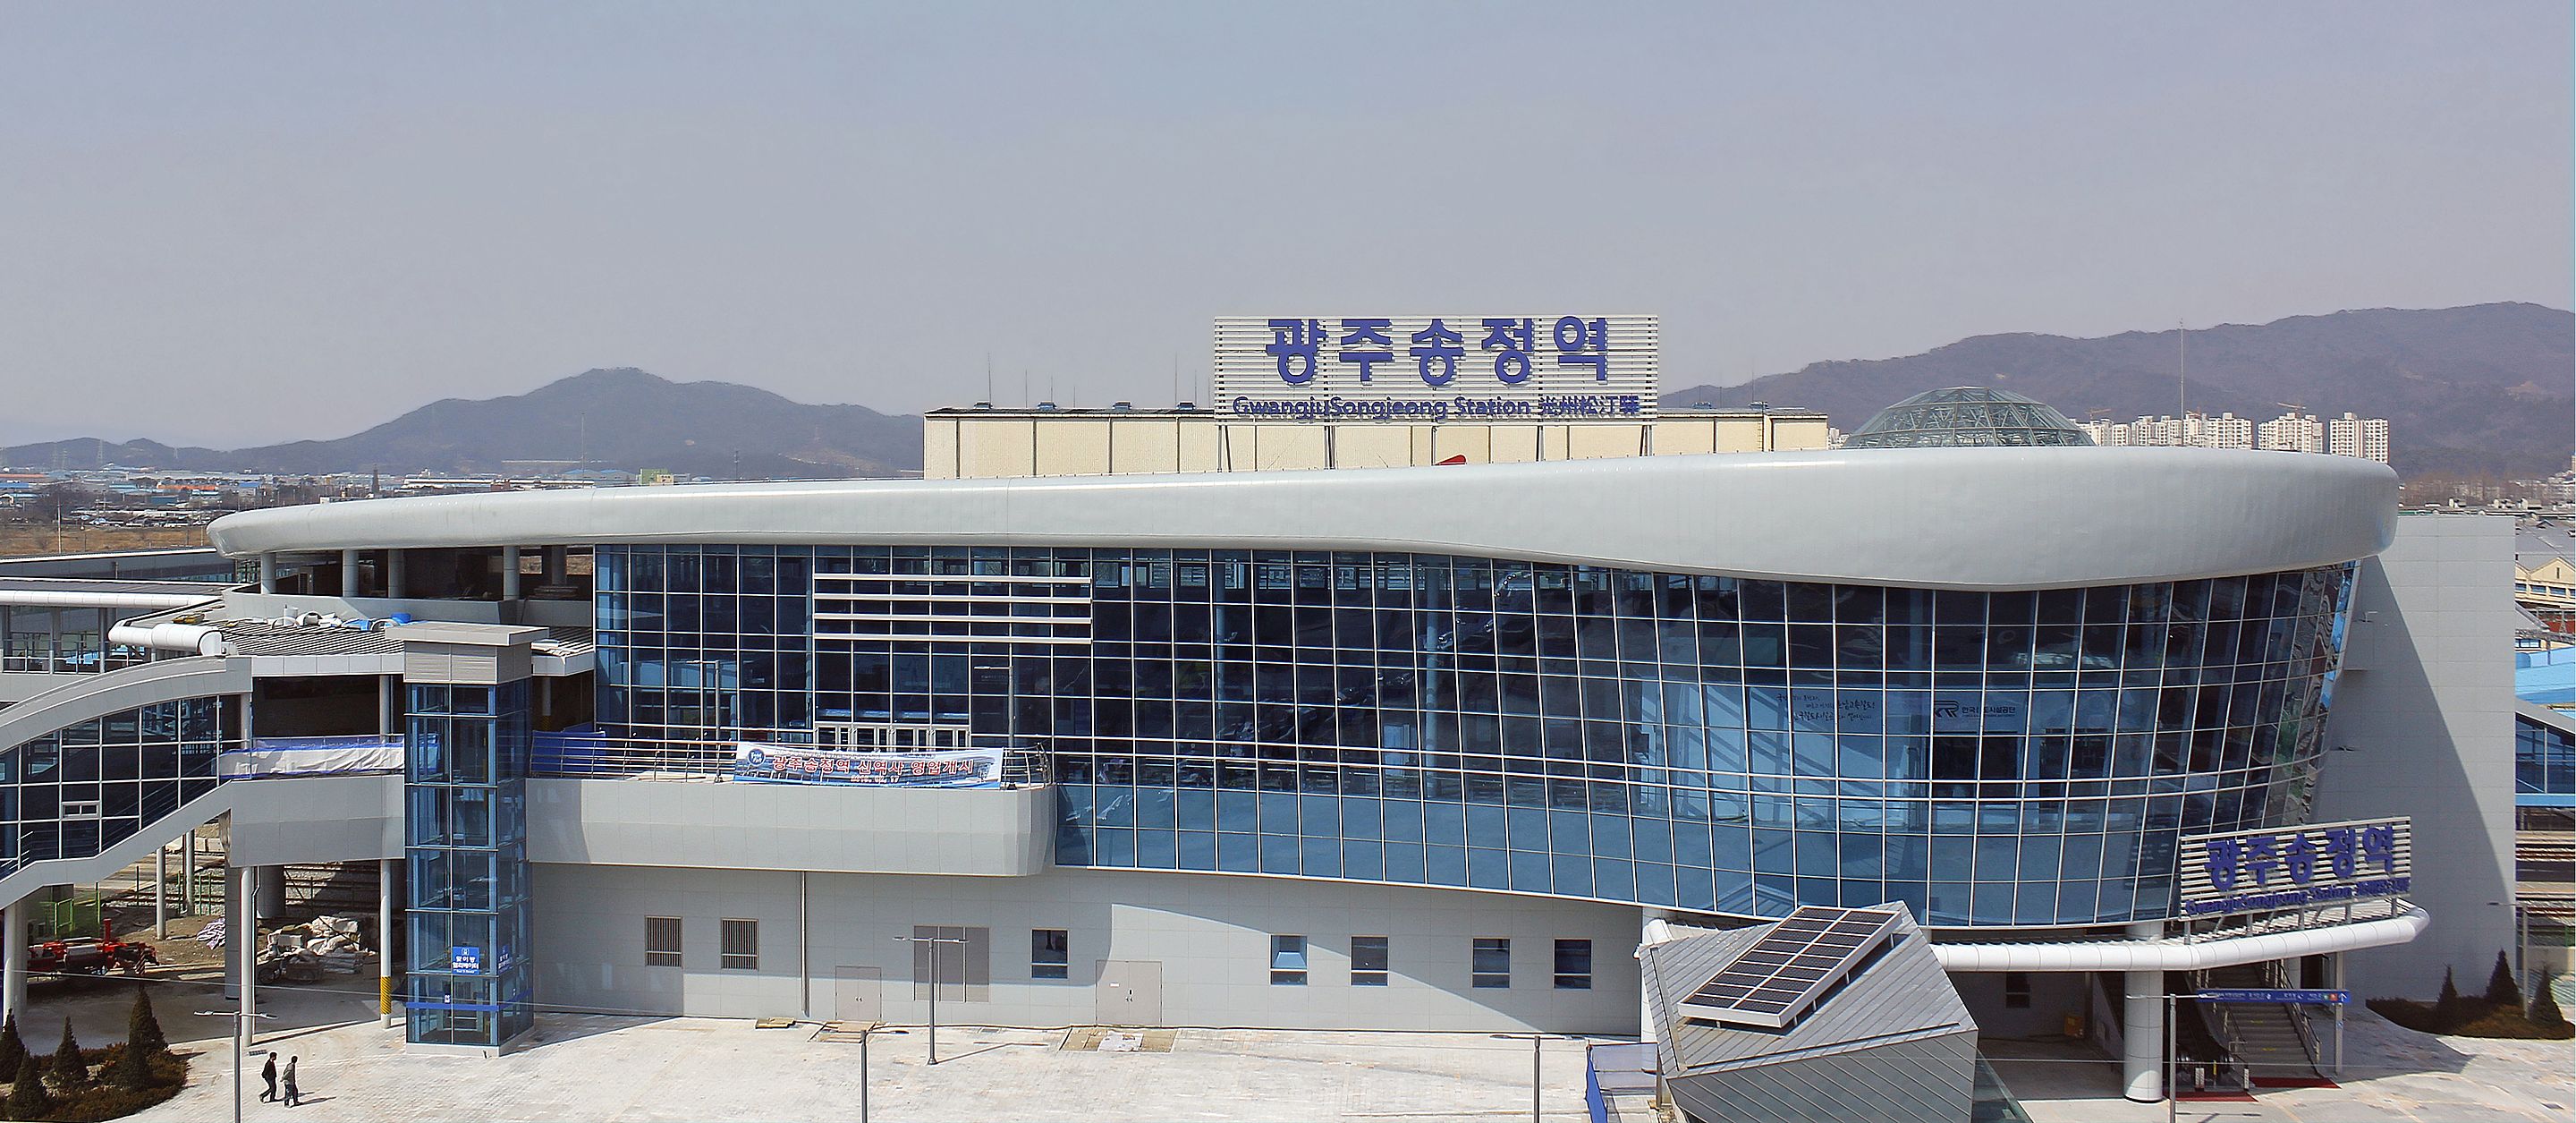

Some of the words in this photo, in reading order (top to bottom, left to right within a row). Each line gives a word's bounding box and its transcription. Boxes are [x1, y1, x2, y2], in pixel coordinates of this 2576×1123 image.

[1266, 316, 1609, 386] 광주송정역
[1454, 396, 1530, 415] Station
[773, 755, 851, 774] 광주송정역
[857, 760, 904, 775] 신역사
[911, 759, 973, 775] 영업개시
[2204, 825, 2395, 892] 광주송정역
[2309, 884, 2352, 900] Station
